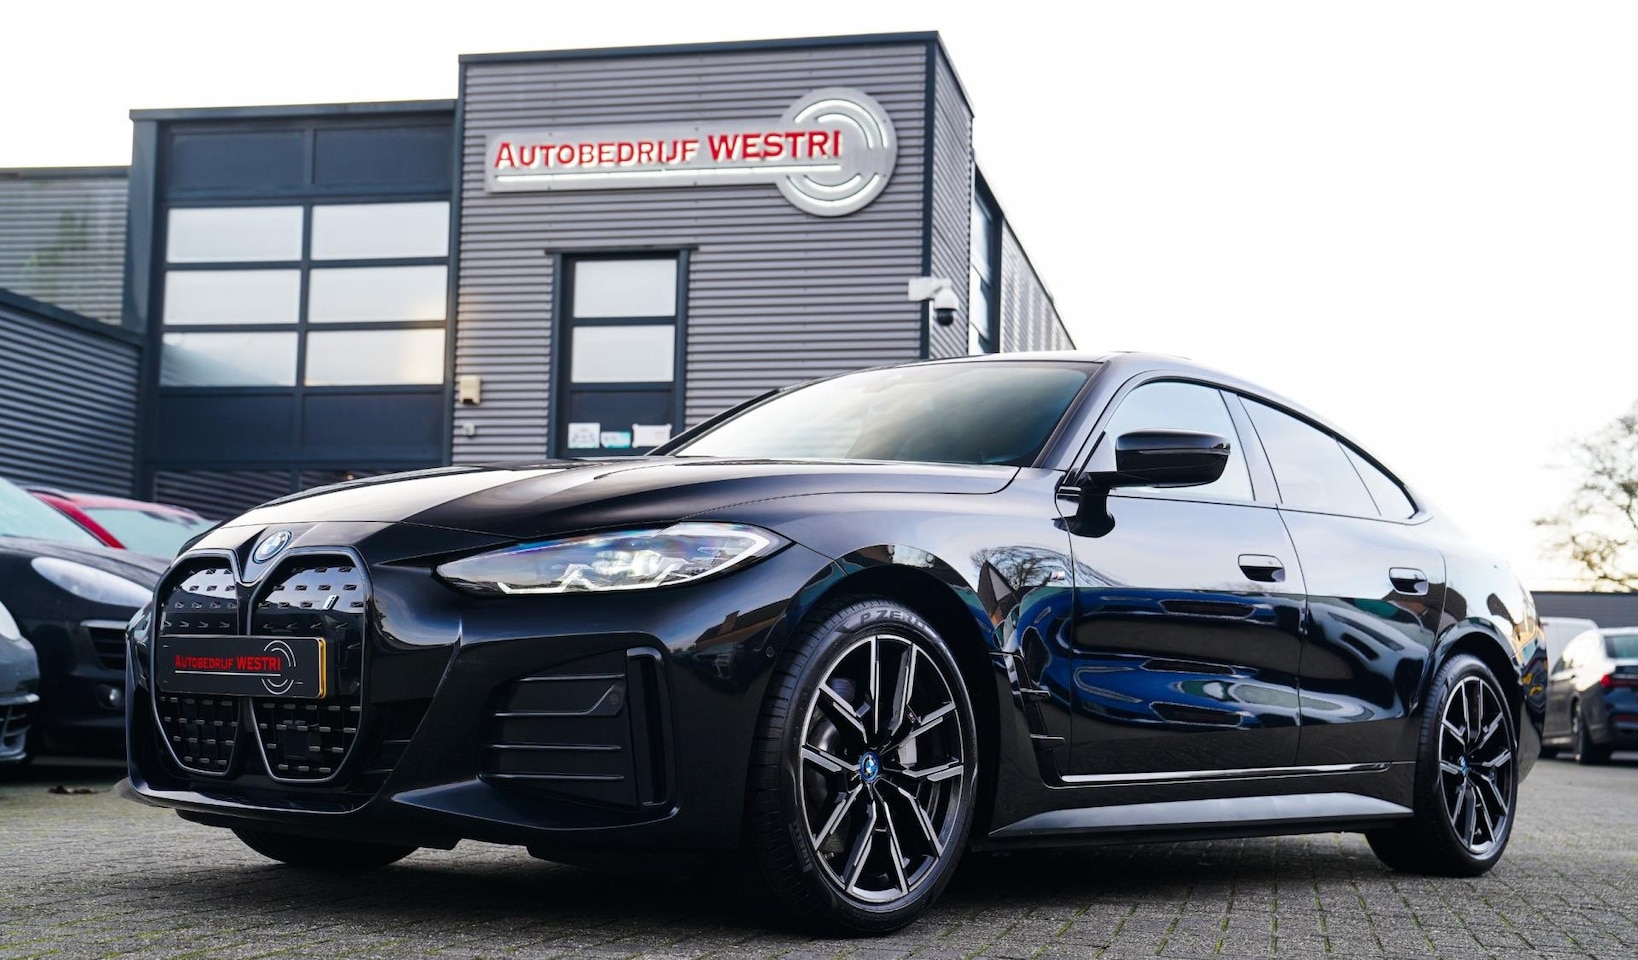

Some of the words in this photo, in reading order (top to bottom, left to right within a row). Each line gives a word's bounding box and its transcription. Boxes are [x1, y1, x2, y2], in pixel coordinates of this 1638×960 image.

[494, 138, 699, 168] AUTOBEDRIJF
[707, 129, 842, 161] WESTRI
[174, 655, 235, 670] AUTOBEDRIJF
[235, 655, 282, 672] WESTRI
